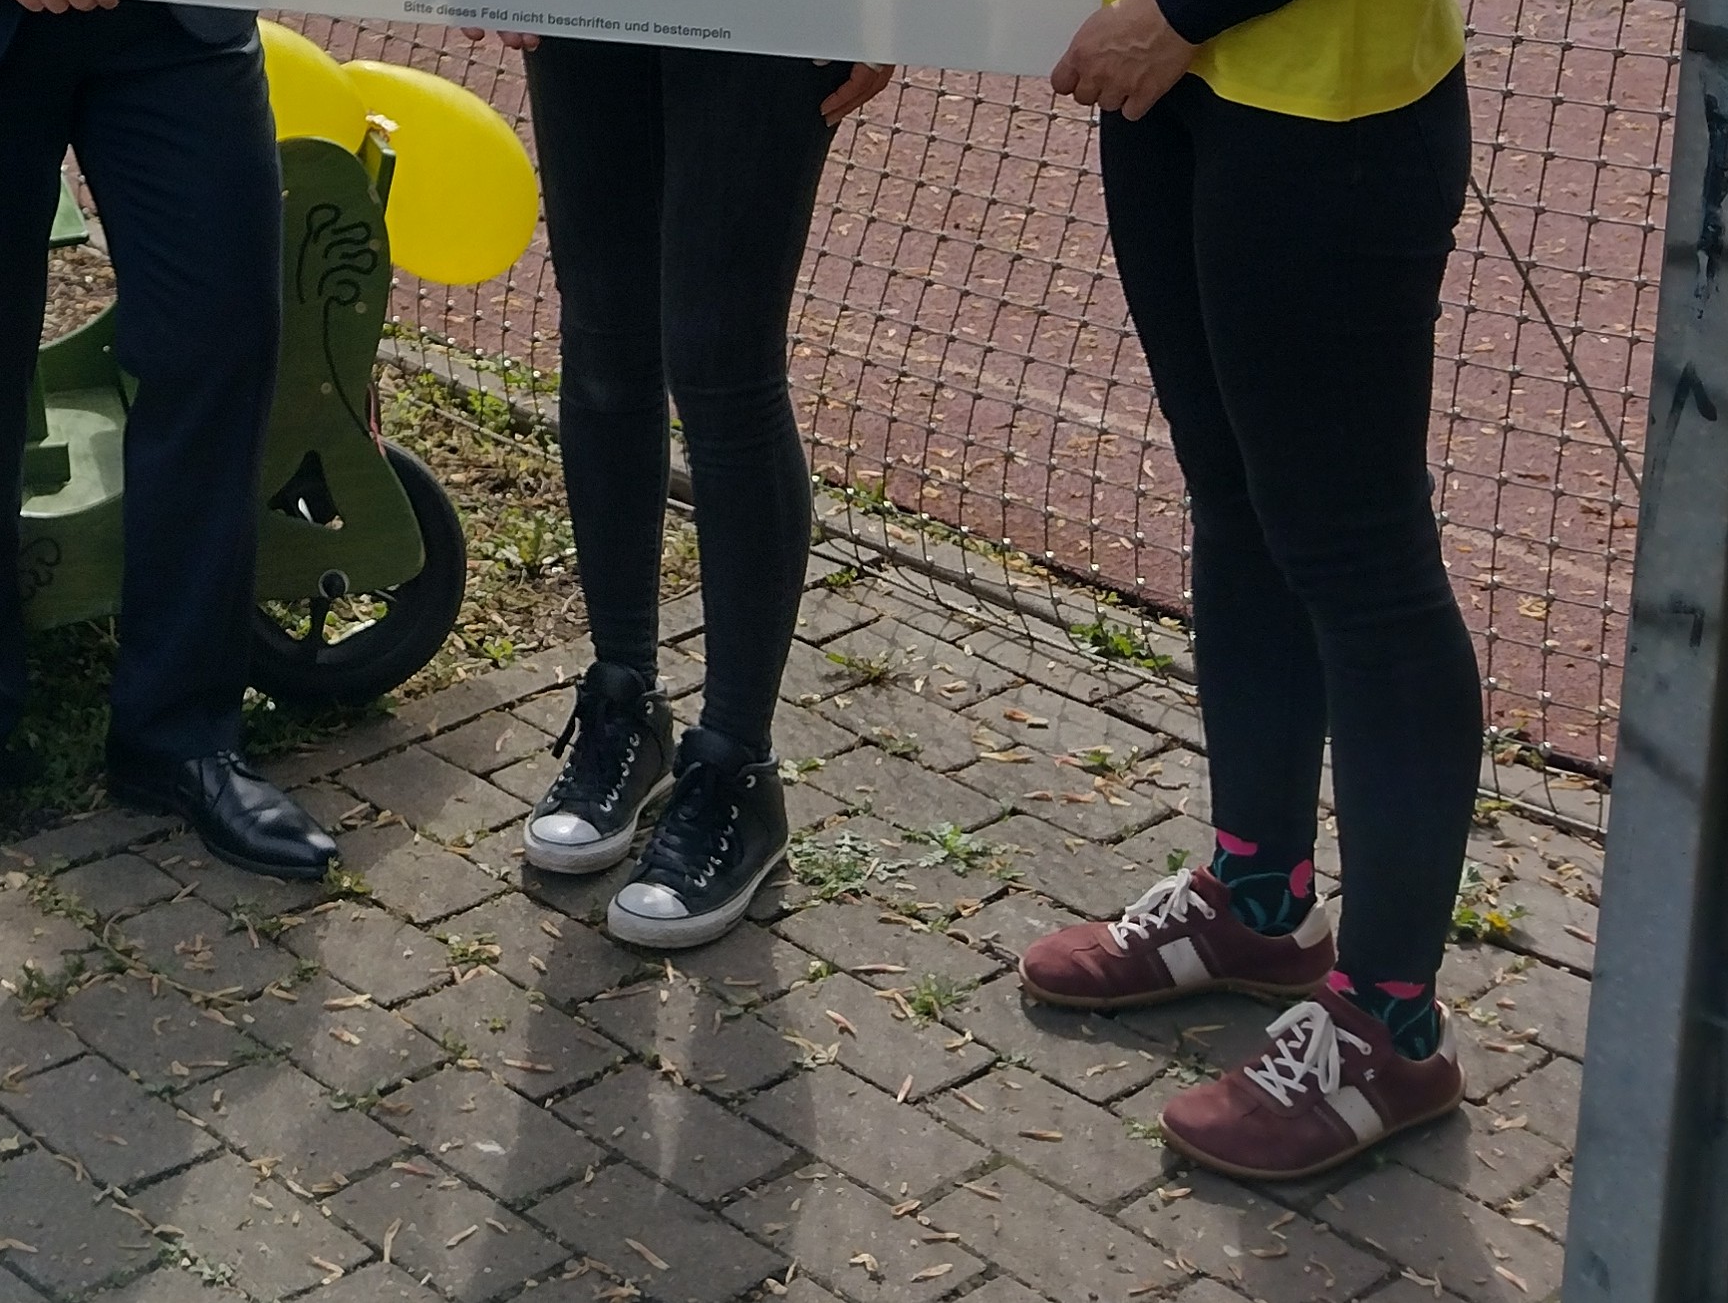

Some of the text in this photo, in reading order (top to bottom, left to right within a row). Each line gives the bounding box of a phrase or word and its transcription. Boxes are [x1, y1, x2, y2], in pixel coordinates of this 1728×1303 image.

[403, 0, 732, 40] Bitte dieses Feld nicht beschriften und bestempeln
